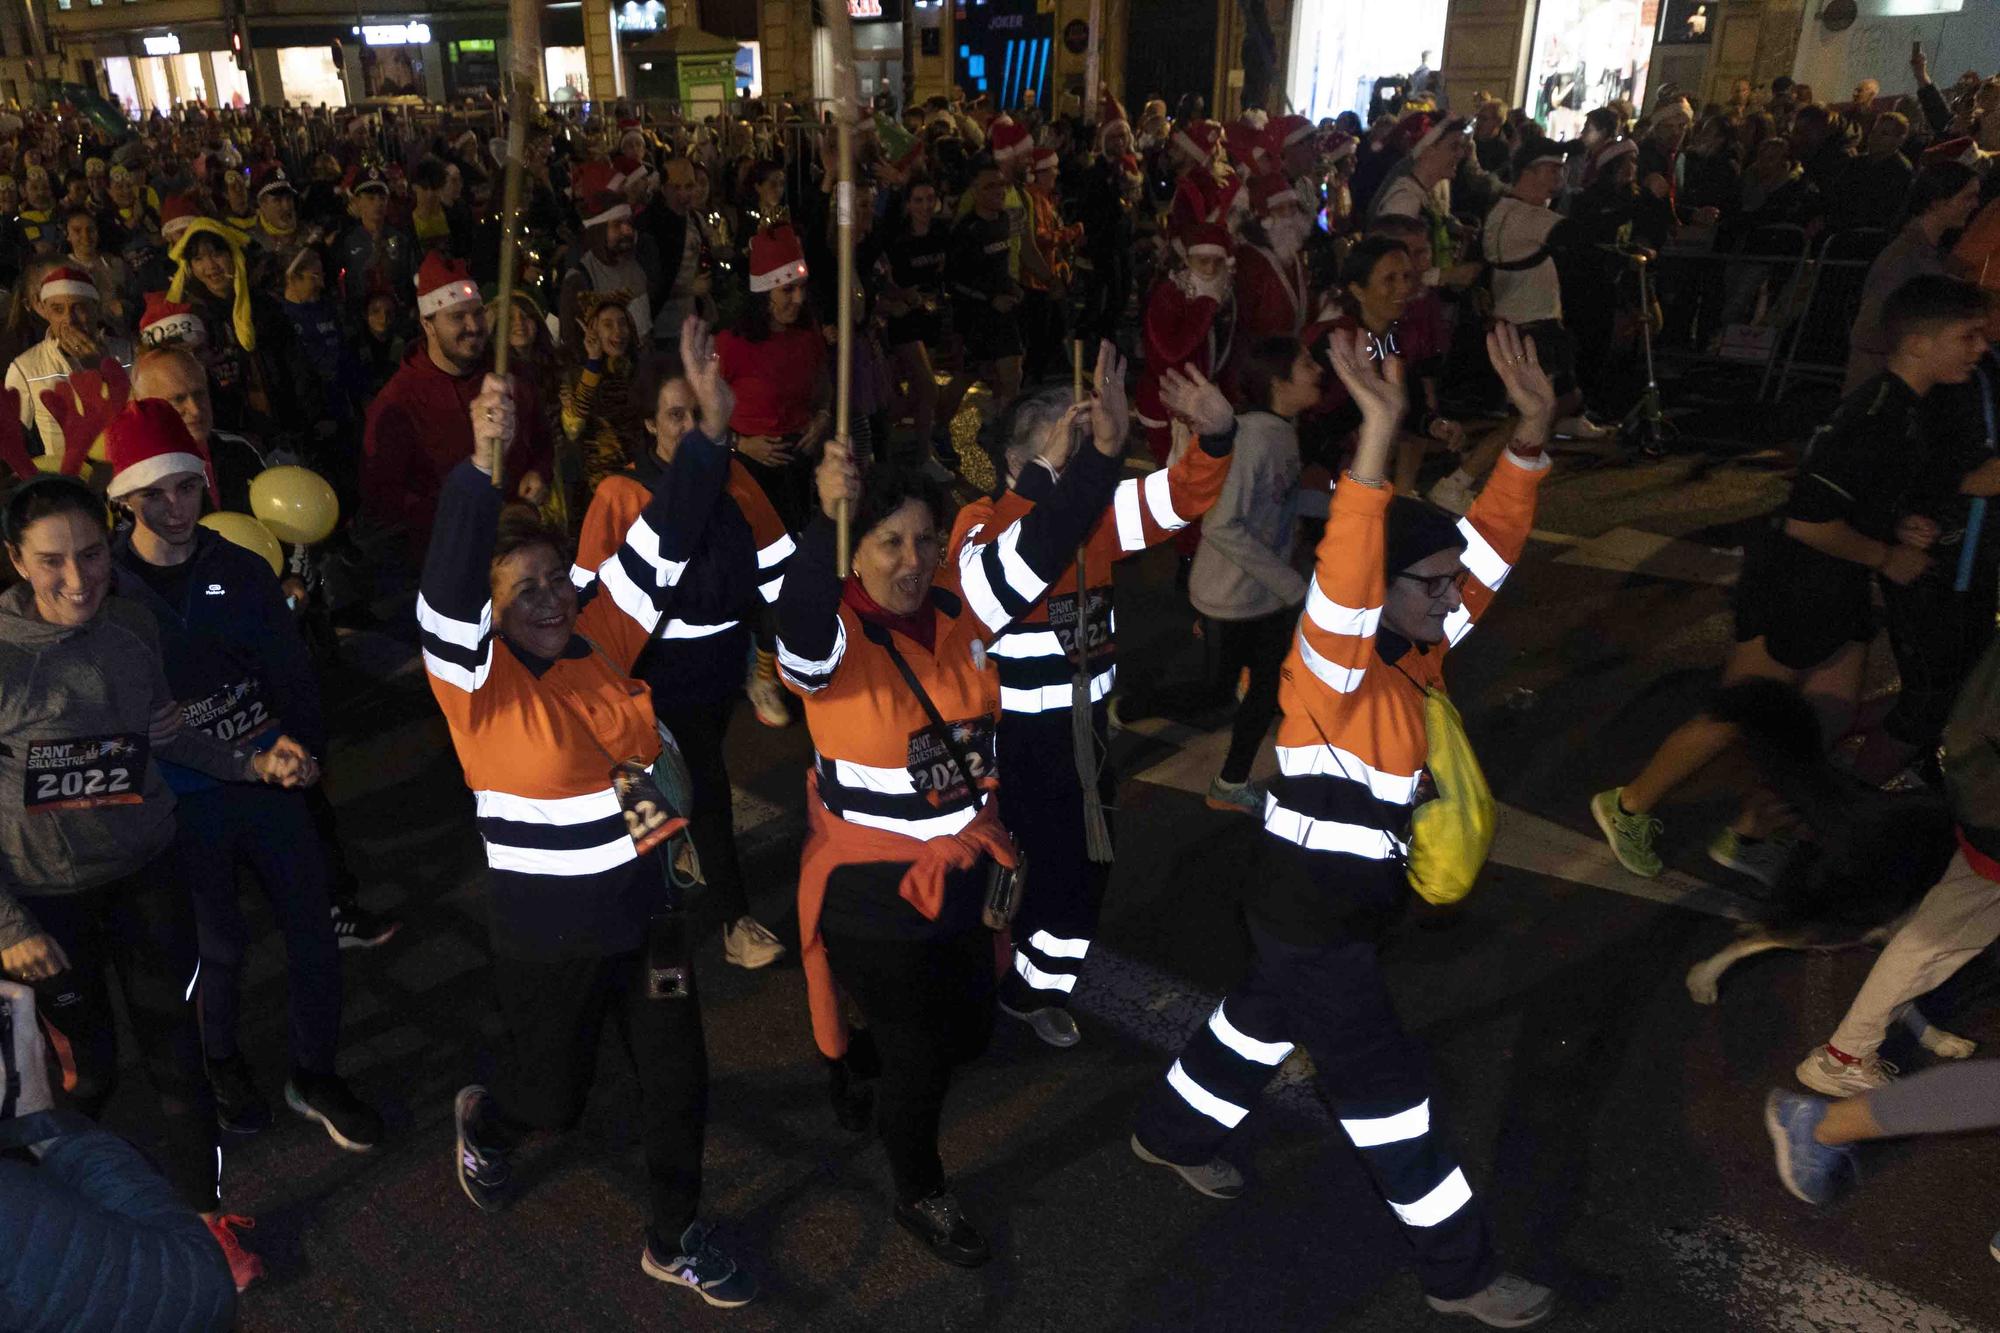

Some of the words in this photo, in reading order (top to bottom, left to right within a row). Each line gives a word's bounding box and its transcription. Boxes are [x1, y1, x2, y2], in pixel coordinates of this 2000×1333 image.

[987, 14, 1024, 30] JOKER
[1049, 599, 1074, 616] SANT
[29, 743, 75, 759] SANT
[908, 733, 931, 753] ANT
[36, 767, 132, 800] 2022
